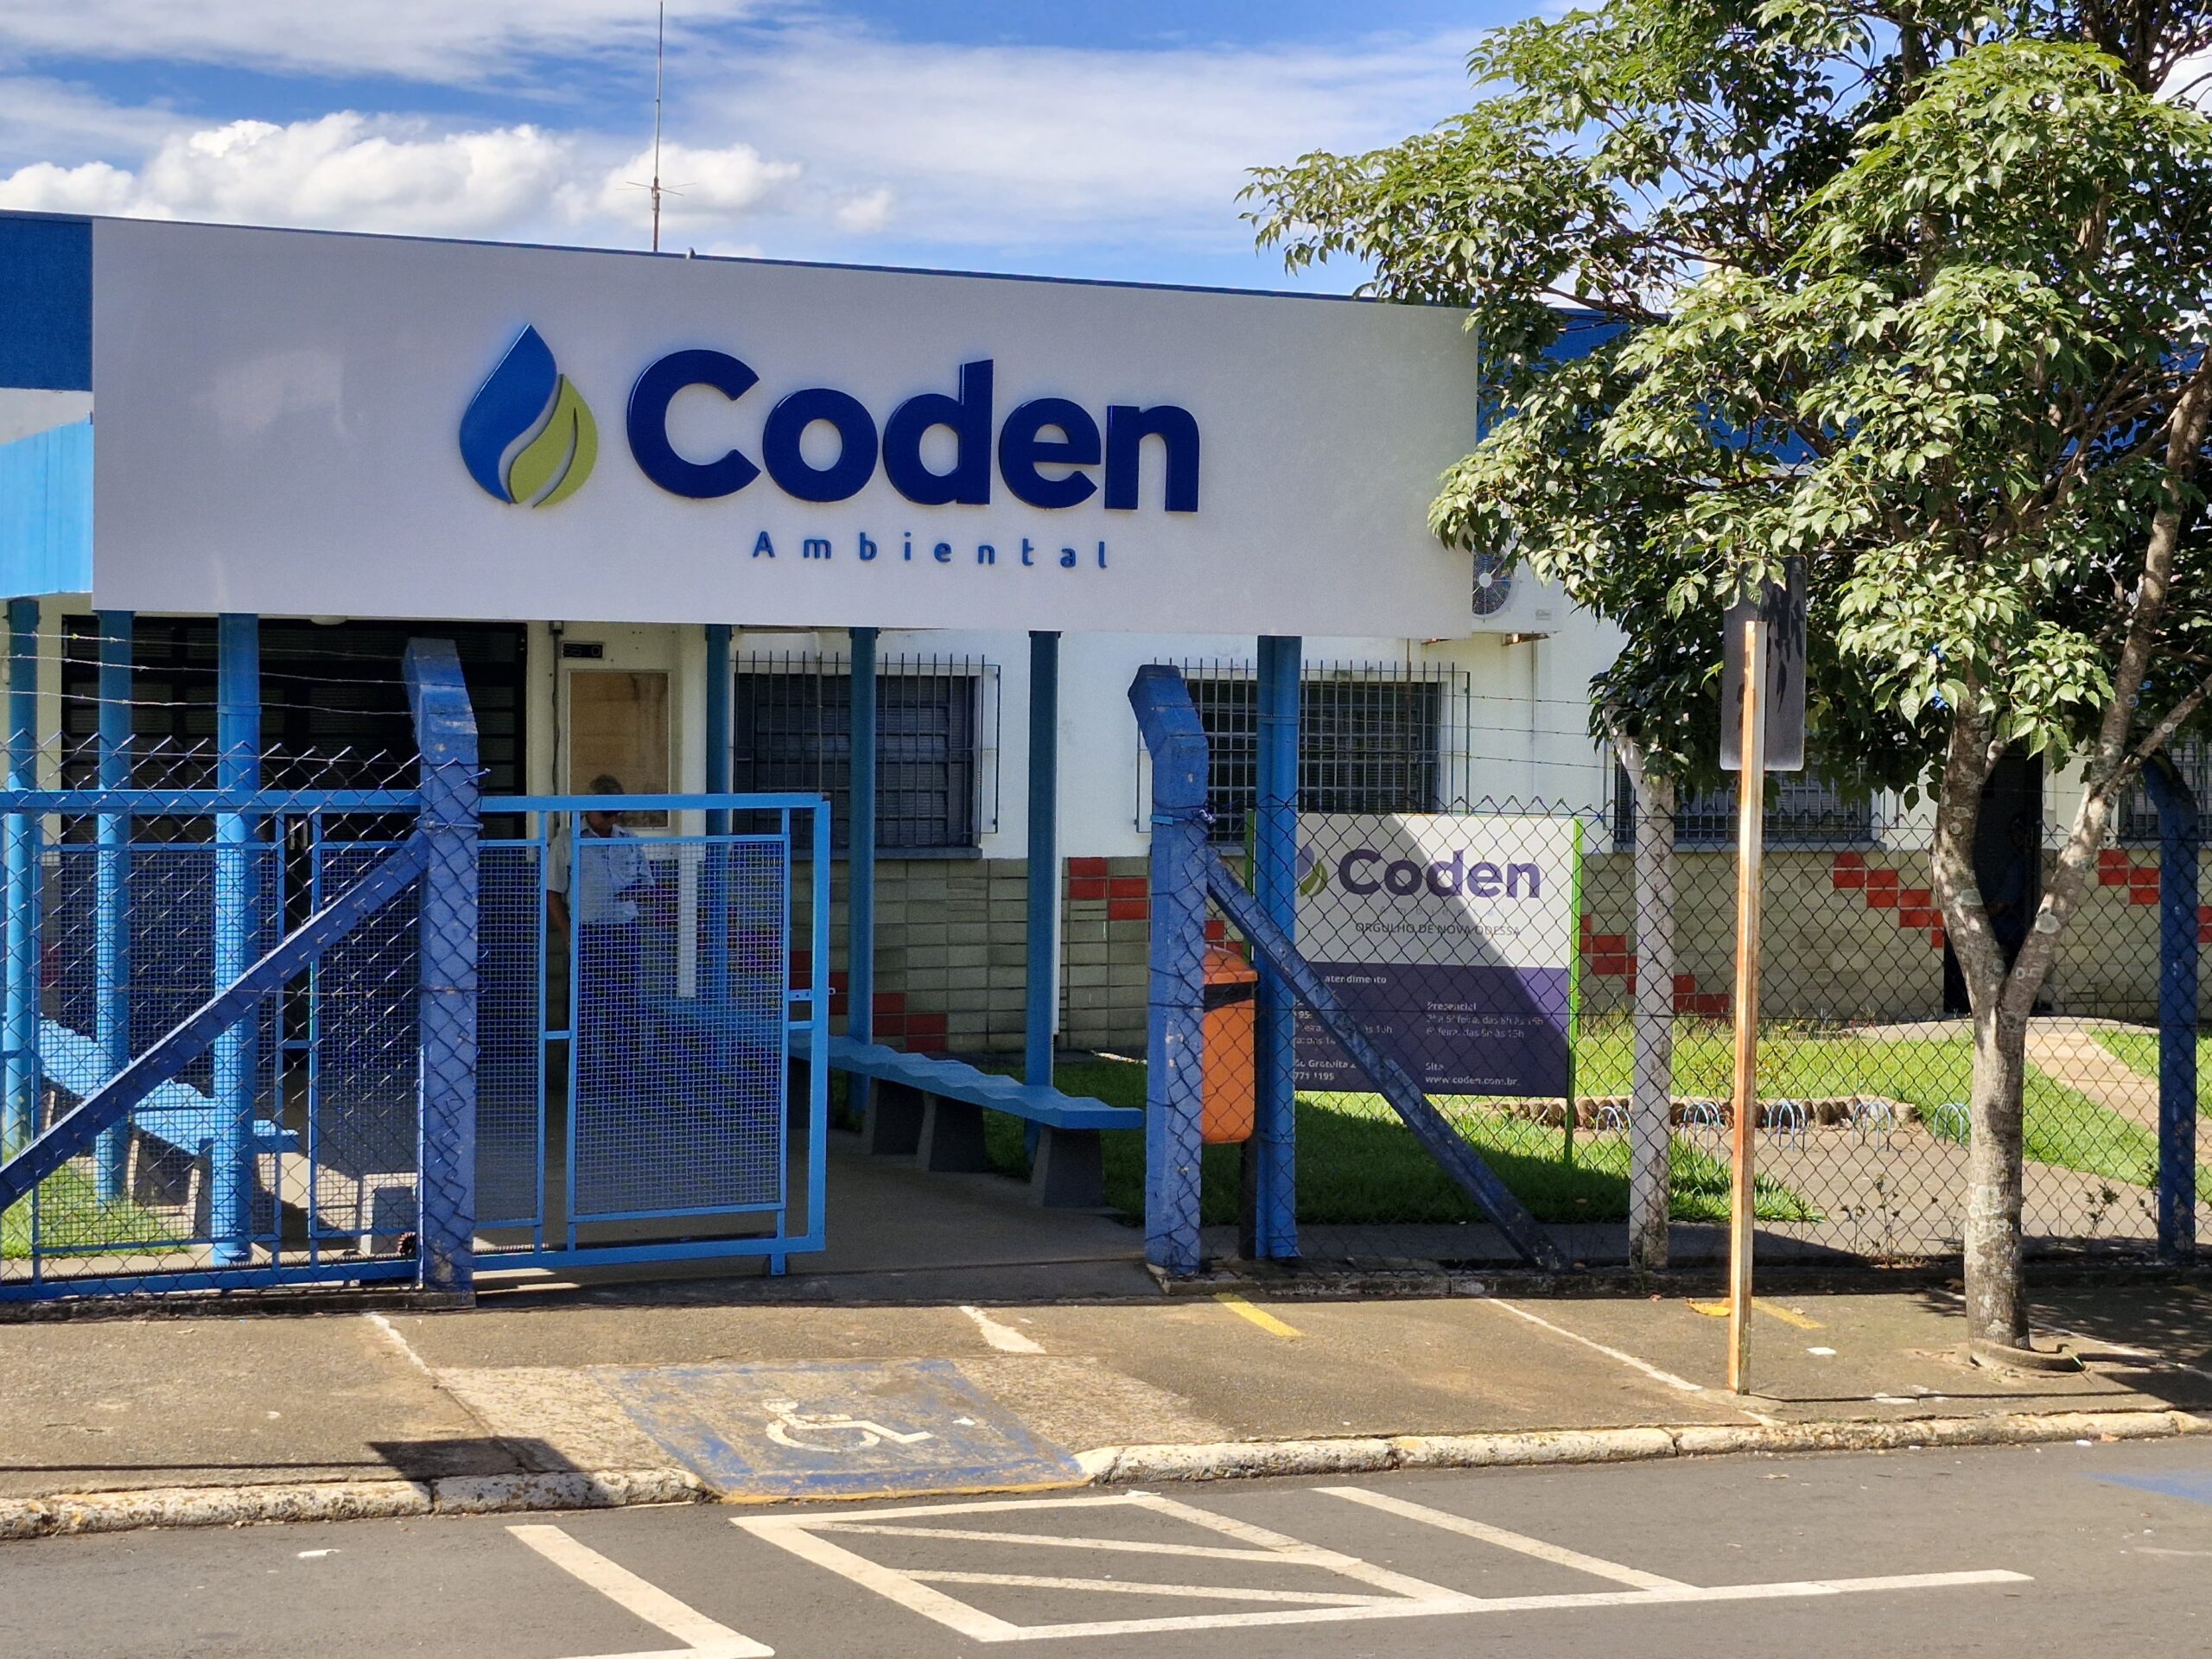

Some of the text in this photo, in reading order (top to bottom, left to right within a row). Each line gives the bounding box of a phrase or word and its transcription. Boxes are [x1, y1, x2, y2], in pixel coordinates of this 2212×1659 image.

[626, 348, 1200, 512] Coden
[753, 530, 1109, 569] Ambiental
[1338, 849, 1541, 899] Coden
[1356, 922, 1522, 937] ORGULHO DE NOVA ODESSA
